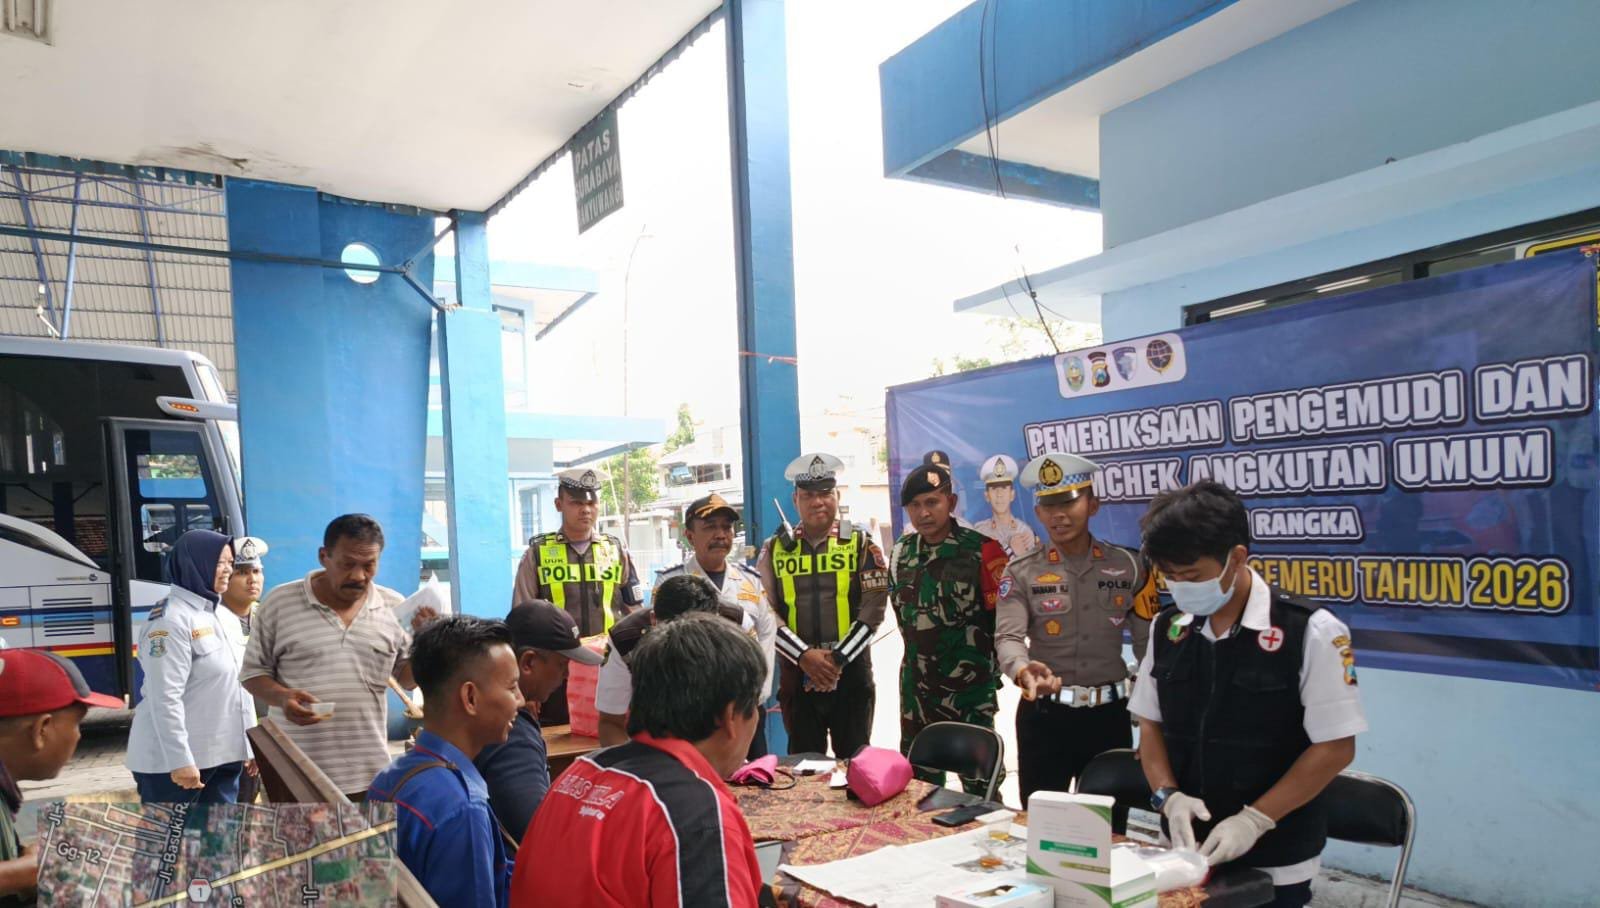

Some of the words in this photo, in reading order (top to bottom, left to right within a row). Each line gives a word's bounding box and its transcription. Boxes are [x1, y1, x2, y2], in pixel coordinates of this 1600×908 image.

[576, 129, 610, 174] PATAS
[575, 152, 620, 200] SURABAYA
[1026, 403, 1221, 458] PEMERIKSAAN
[1232, 373, 1461, 438] PENGEMUDI
[1479, 358, 1585, 415] DAN
[1398, 432, 1547, 484] UMUM
[1254, 509, 1359, 537] RANGKA
[1098, 580, 1131, 590] POLRI
[1359, 560, 1461, 603] TAHUN
[1470, 562, 1564, 608] 2026
